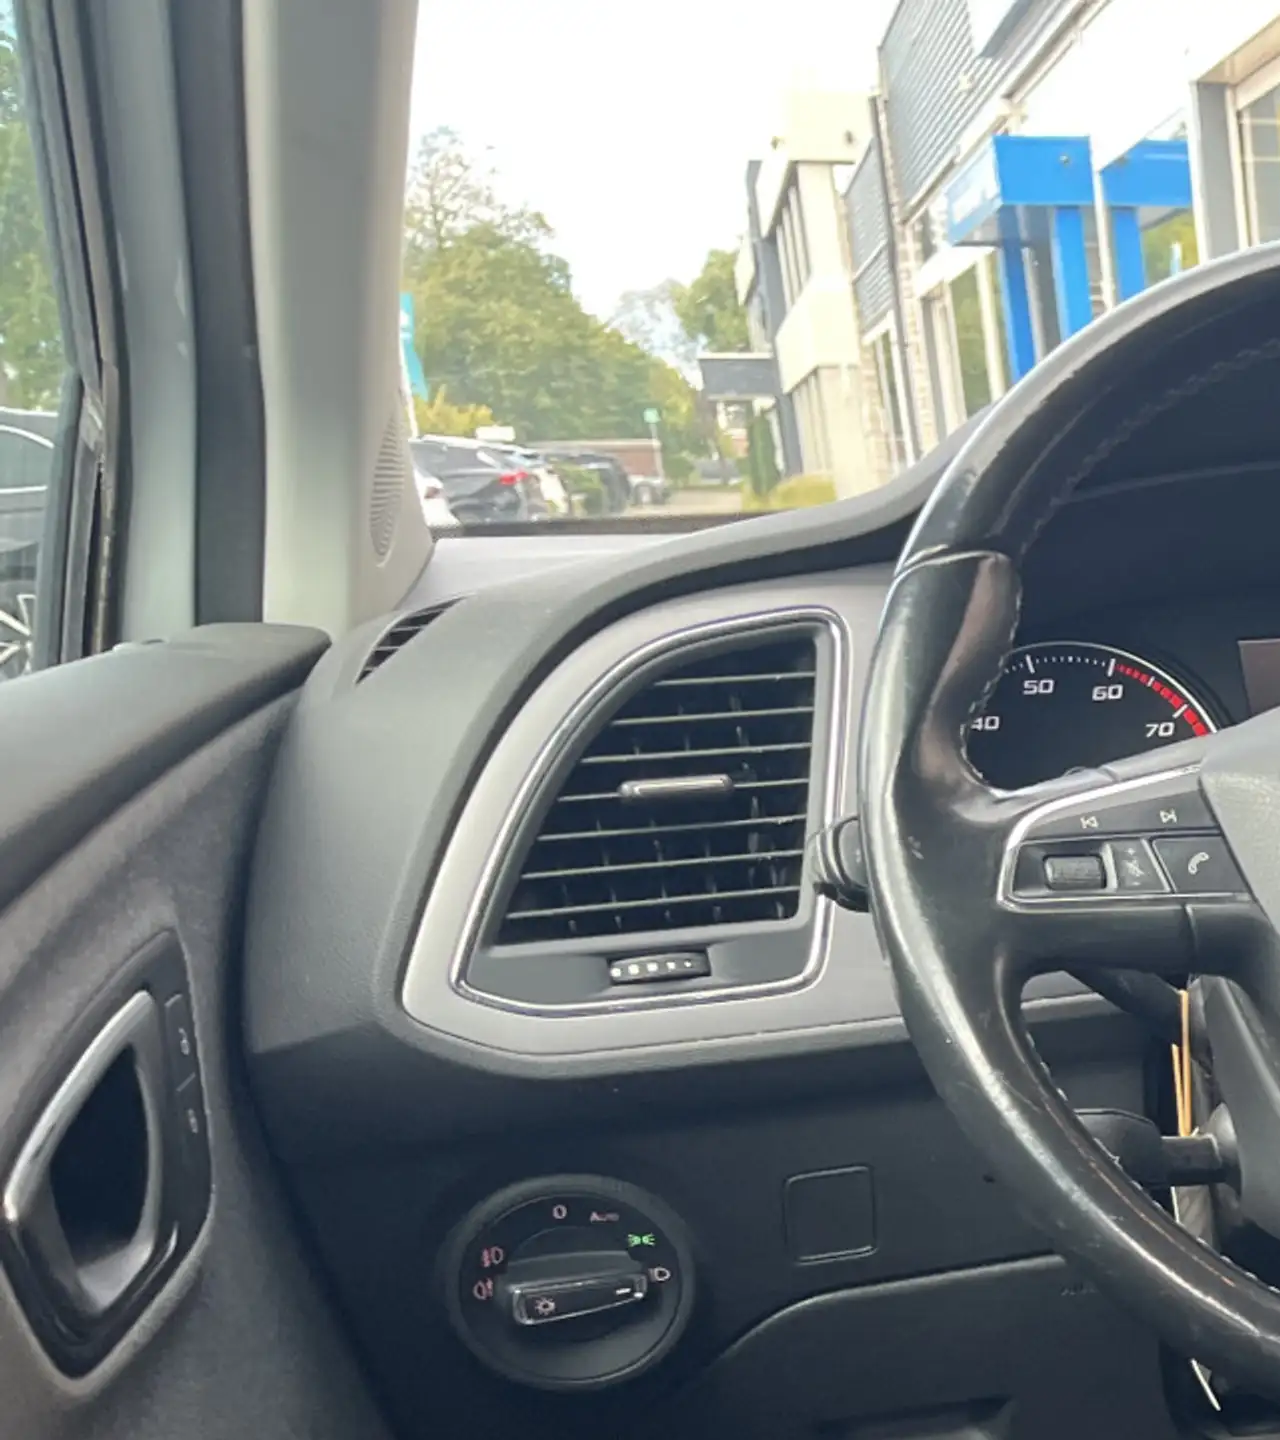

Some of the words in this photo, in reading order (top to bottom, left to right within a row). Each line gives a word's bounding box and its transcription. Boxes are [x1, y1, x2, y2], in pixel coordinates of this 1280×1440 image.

[1022, 679, 1055, 696] 50
[1091, 684, 1124, 702] 60
[971, 716, 1000, 732] 40
[1145, 721, 1176, 738] 70
